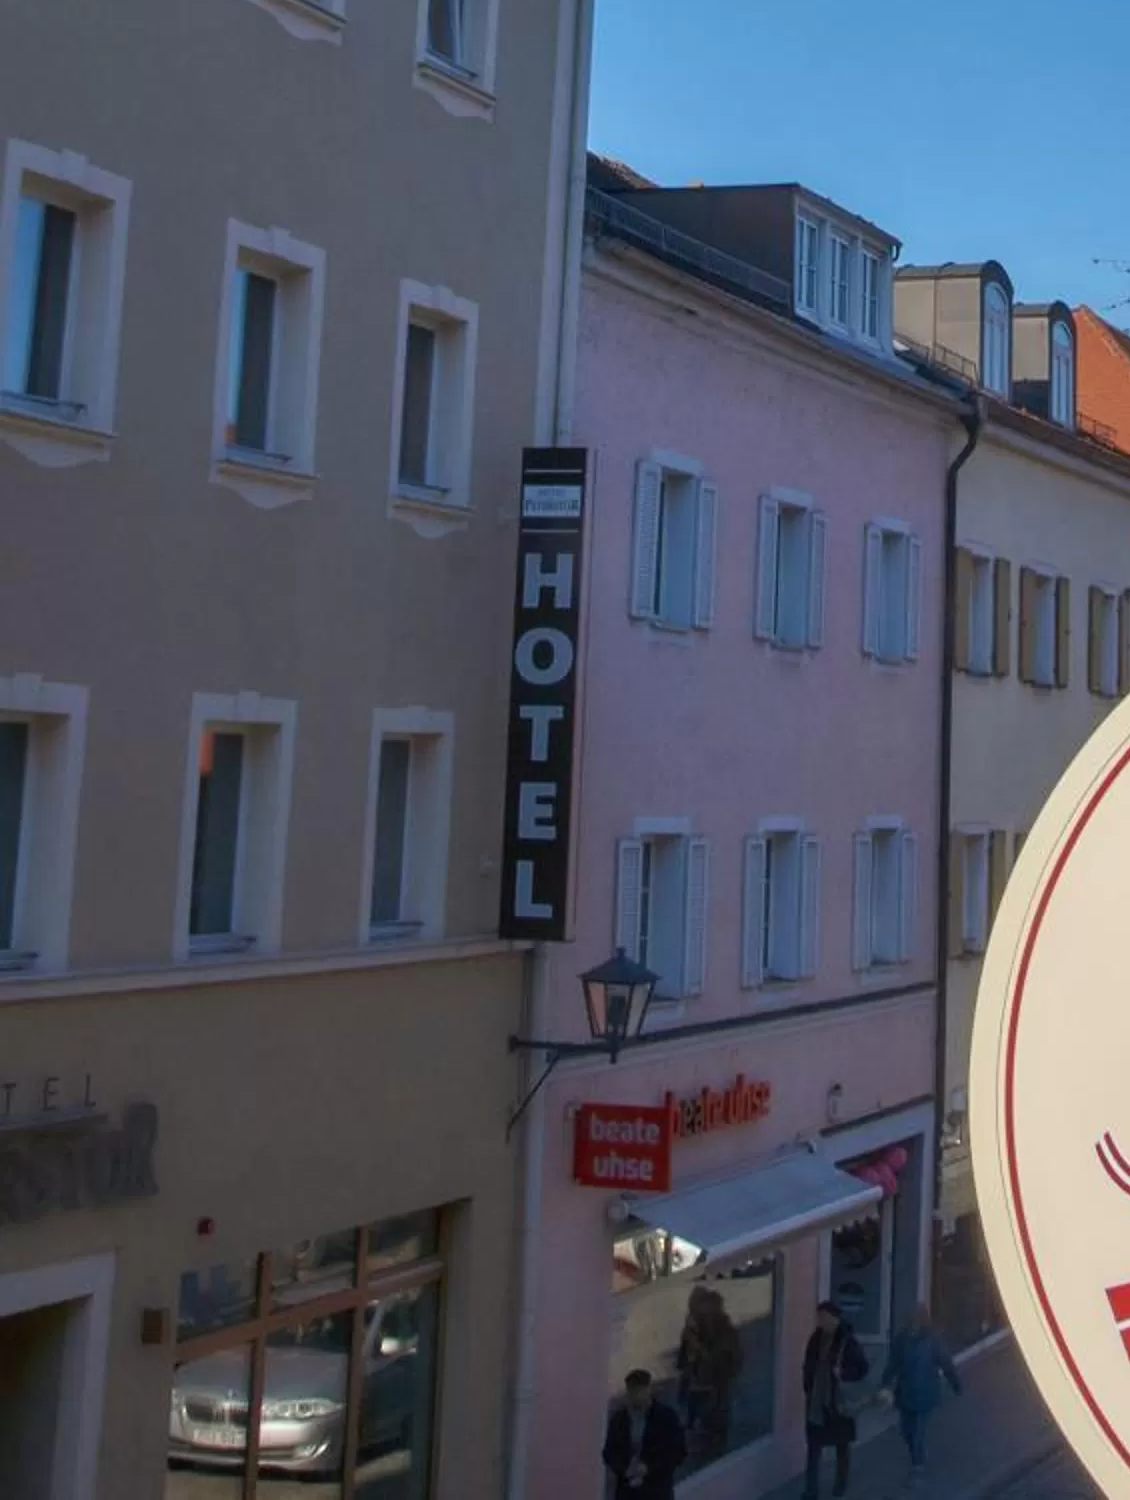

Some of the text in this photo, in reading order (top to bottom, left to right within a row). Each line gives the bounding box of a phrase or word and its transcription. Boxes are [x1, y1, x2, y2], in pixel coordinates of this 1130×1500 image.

[514, 552, 575, 919] HOTEL
[588, 1111, 660, 1145] beate
[593, 1150, 654, 1182] uhse
